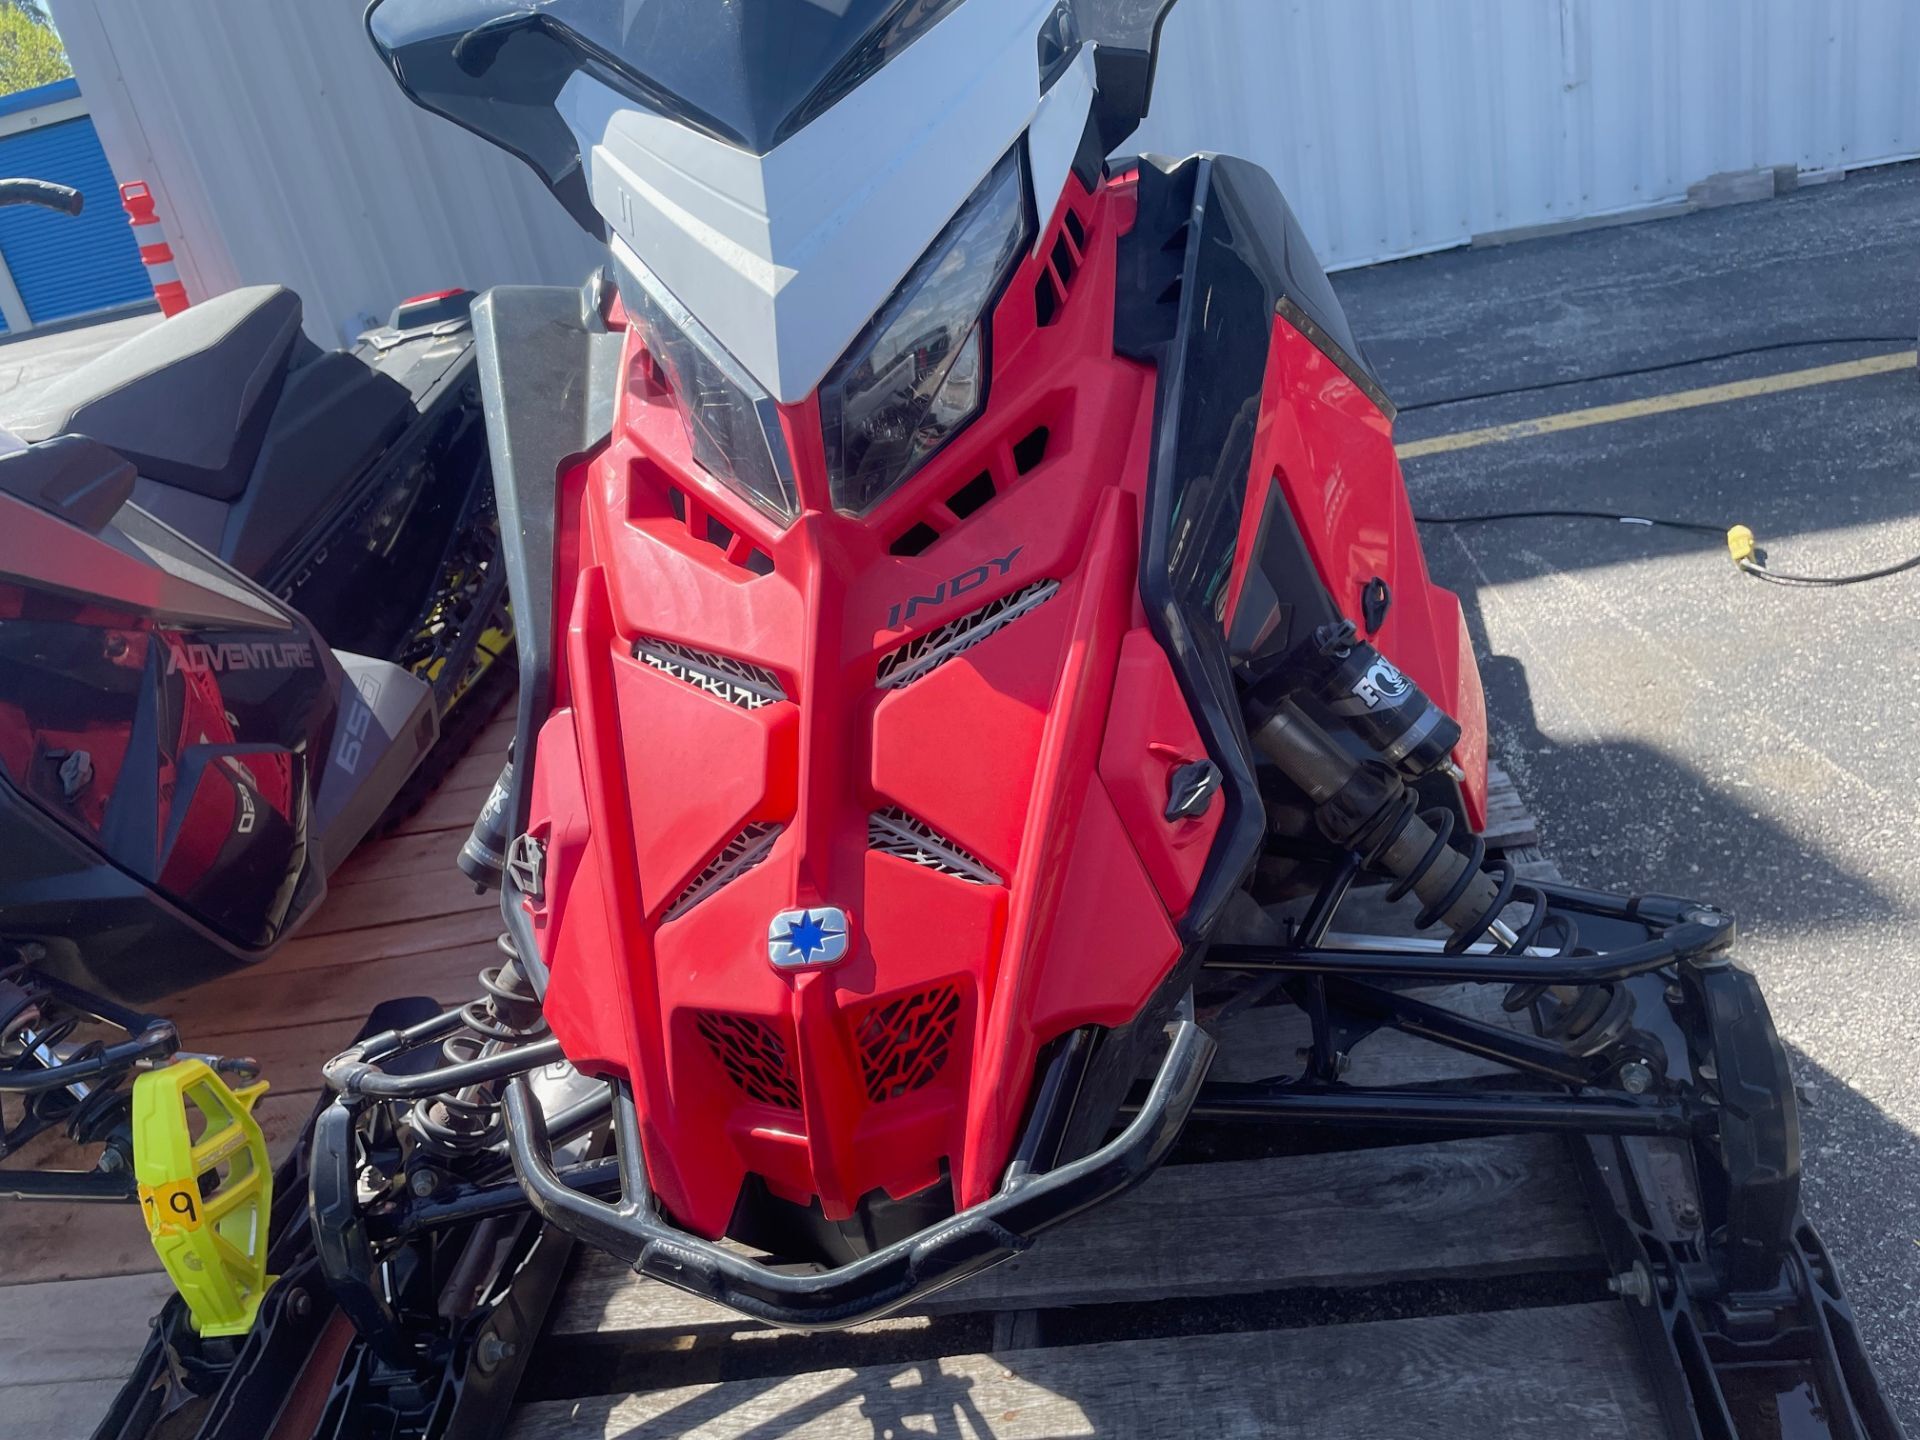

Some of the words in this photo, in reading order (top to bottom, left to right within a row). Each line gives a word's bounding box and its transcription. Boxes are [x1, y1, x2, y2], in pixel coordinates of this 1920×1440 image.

[887, 545, 1024, 629] INDY
[166, 643, 315, 675] ADVENTURE
[335, 672, 382, 775] 650
